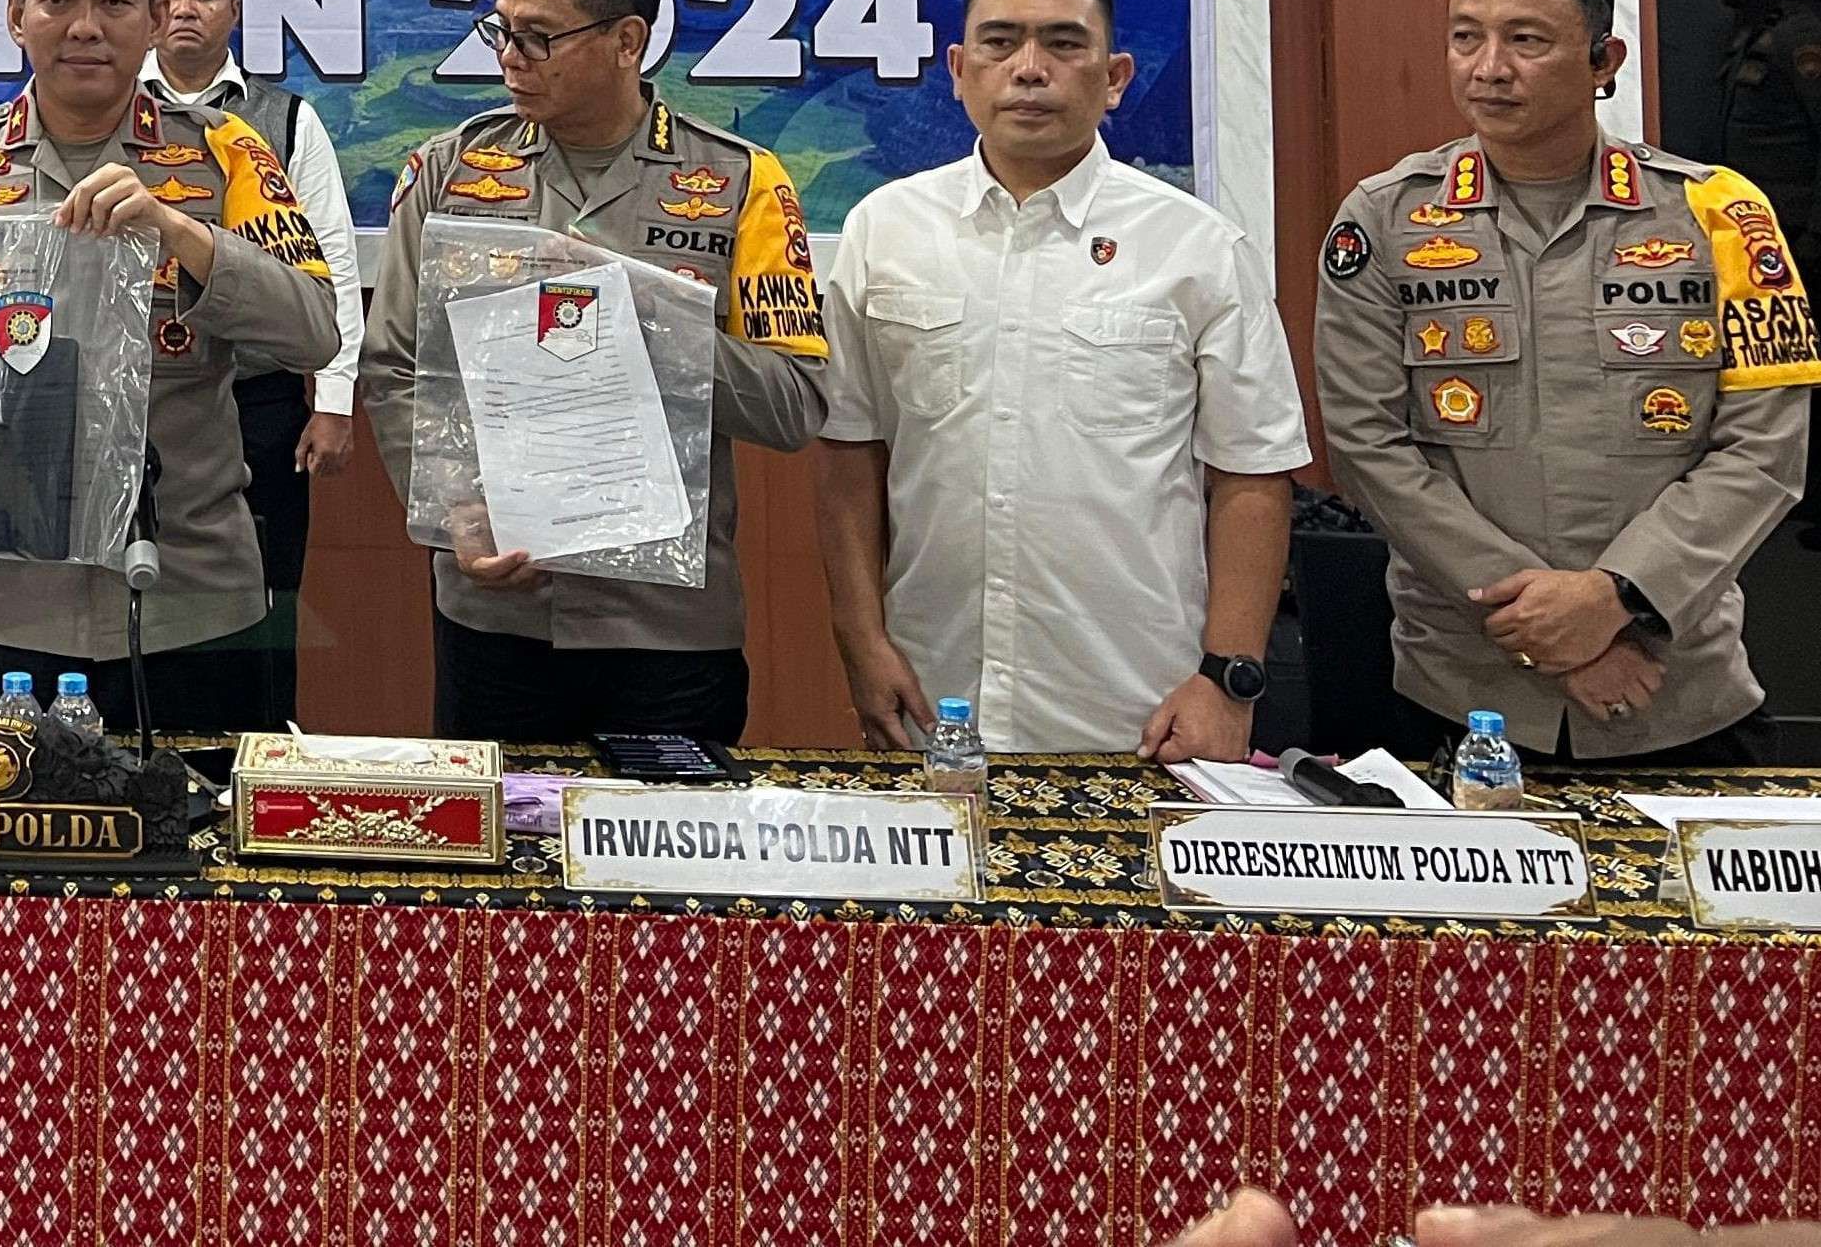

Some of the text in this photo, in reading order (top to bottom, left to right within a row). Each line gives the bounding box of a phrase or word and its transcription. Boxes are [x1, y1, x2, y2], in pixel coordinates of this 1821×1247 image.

[645, 227, 736, 259] POLRI
[738, 274, 809, 310] KAWAS
[1602, 279, 1712, 305] POLRI
[582, 817, 955, 867] IRWASDA POLDA NTT
[1170, 838, 1575, 886] DIRRESKRIMUM POLDA NTT
[1706, 848, 1821, 893] KABIDH
